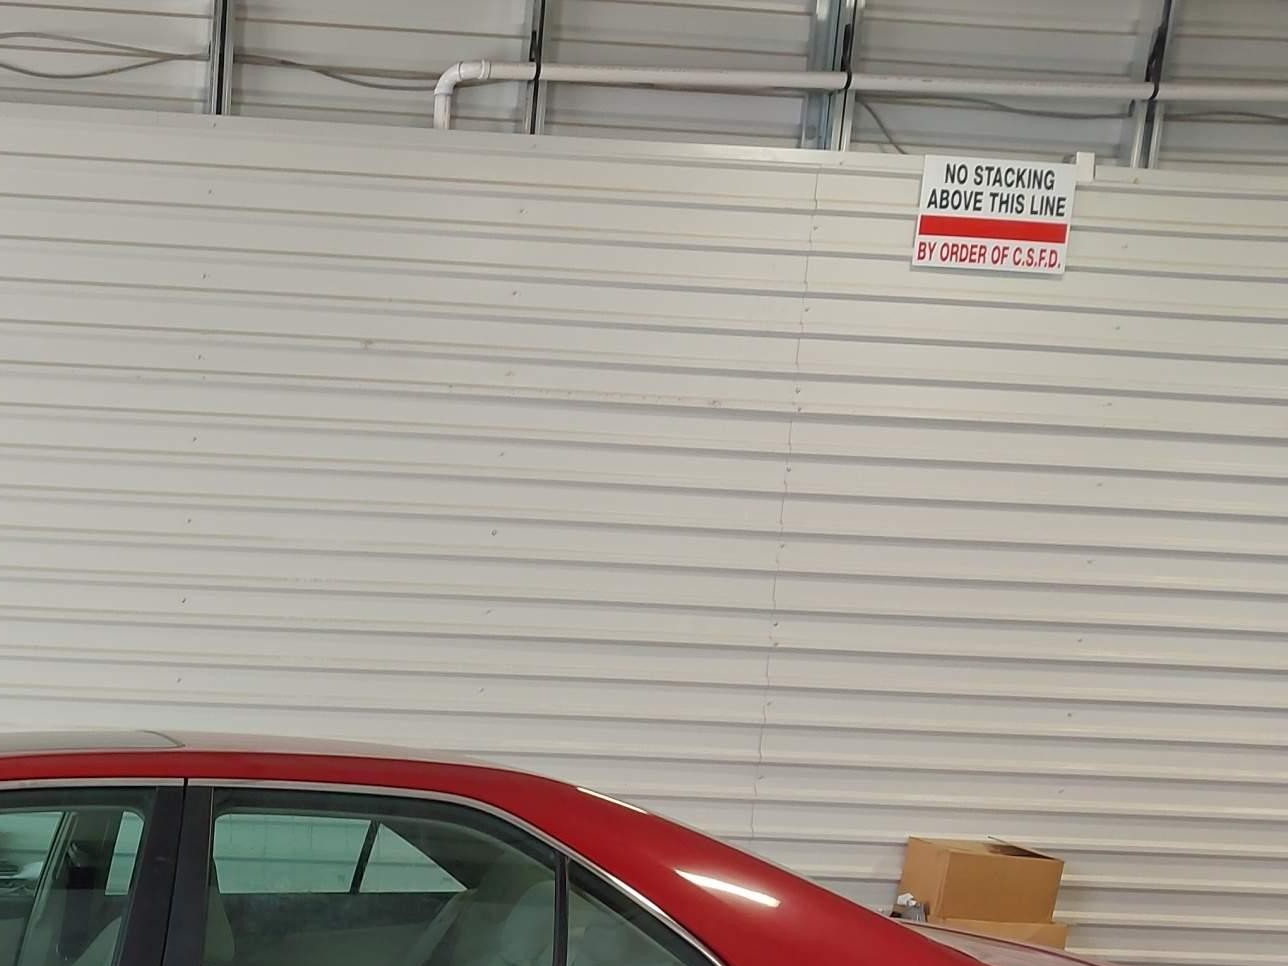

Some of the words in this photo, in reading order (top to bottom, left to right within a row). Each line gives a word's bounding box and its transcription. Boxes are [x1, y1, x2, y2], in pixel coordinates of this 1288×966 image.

[945, 163, 968, 184] NO
[973, 165, 1055, 190] STACKING
[927, 188, 983, 212] ABOVE
[989, 192, 1025, 214] THIS
[1030, 195, 1066, 217] LINE
[917, 241, 938, 260] BY
[939, 242, 987, 264] ORDER
[991, 245, 1010, 265] OF
[1012, 247, 1061, 269] C.S.F.D.
